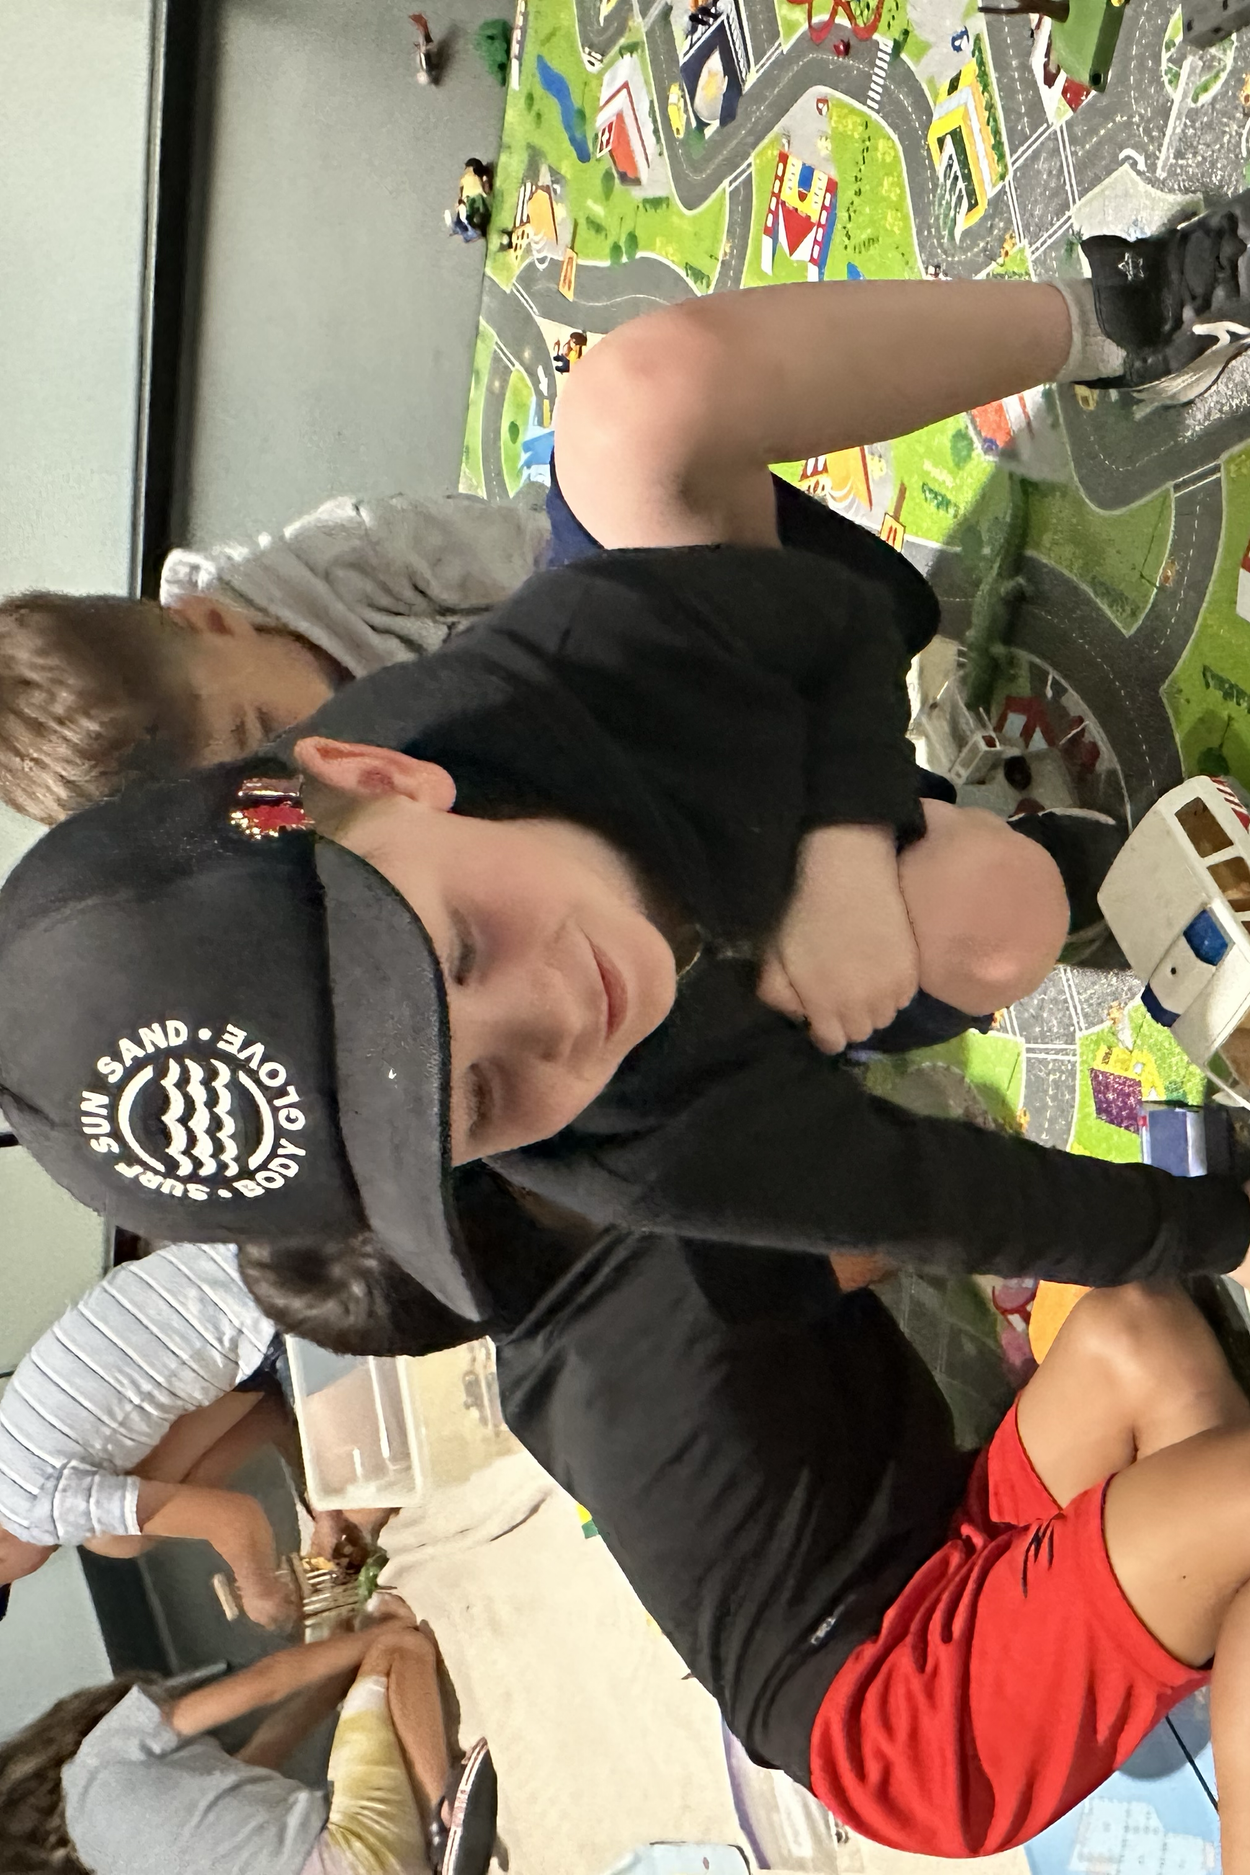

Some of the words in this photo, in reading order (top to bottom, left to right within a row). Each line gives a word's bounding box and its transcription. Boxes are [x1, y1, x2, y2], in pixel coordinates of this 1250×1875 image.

[96, 1018, 190, 1084] SAND
[217, 1022, 306, 1131] GLOVE
[79, 1090, 120, 1155] SUN
[114, 1161, 212, 1202] SURF
[232, 1137, 308, 1200] BODY
